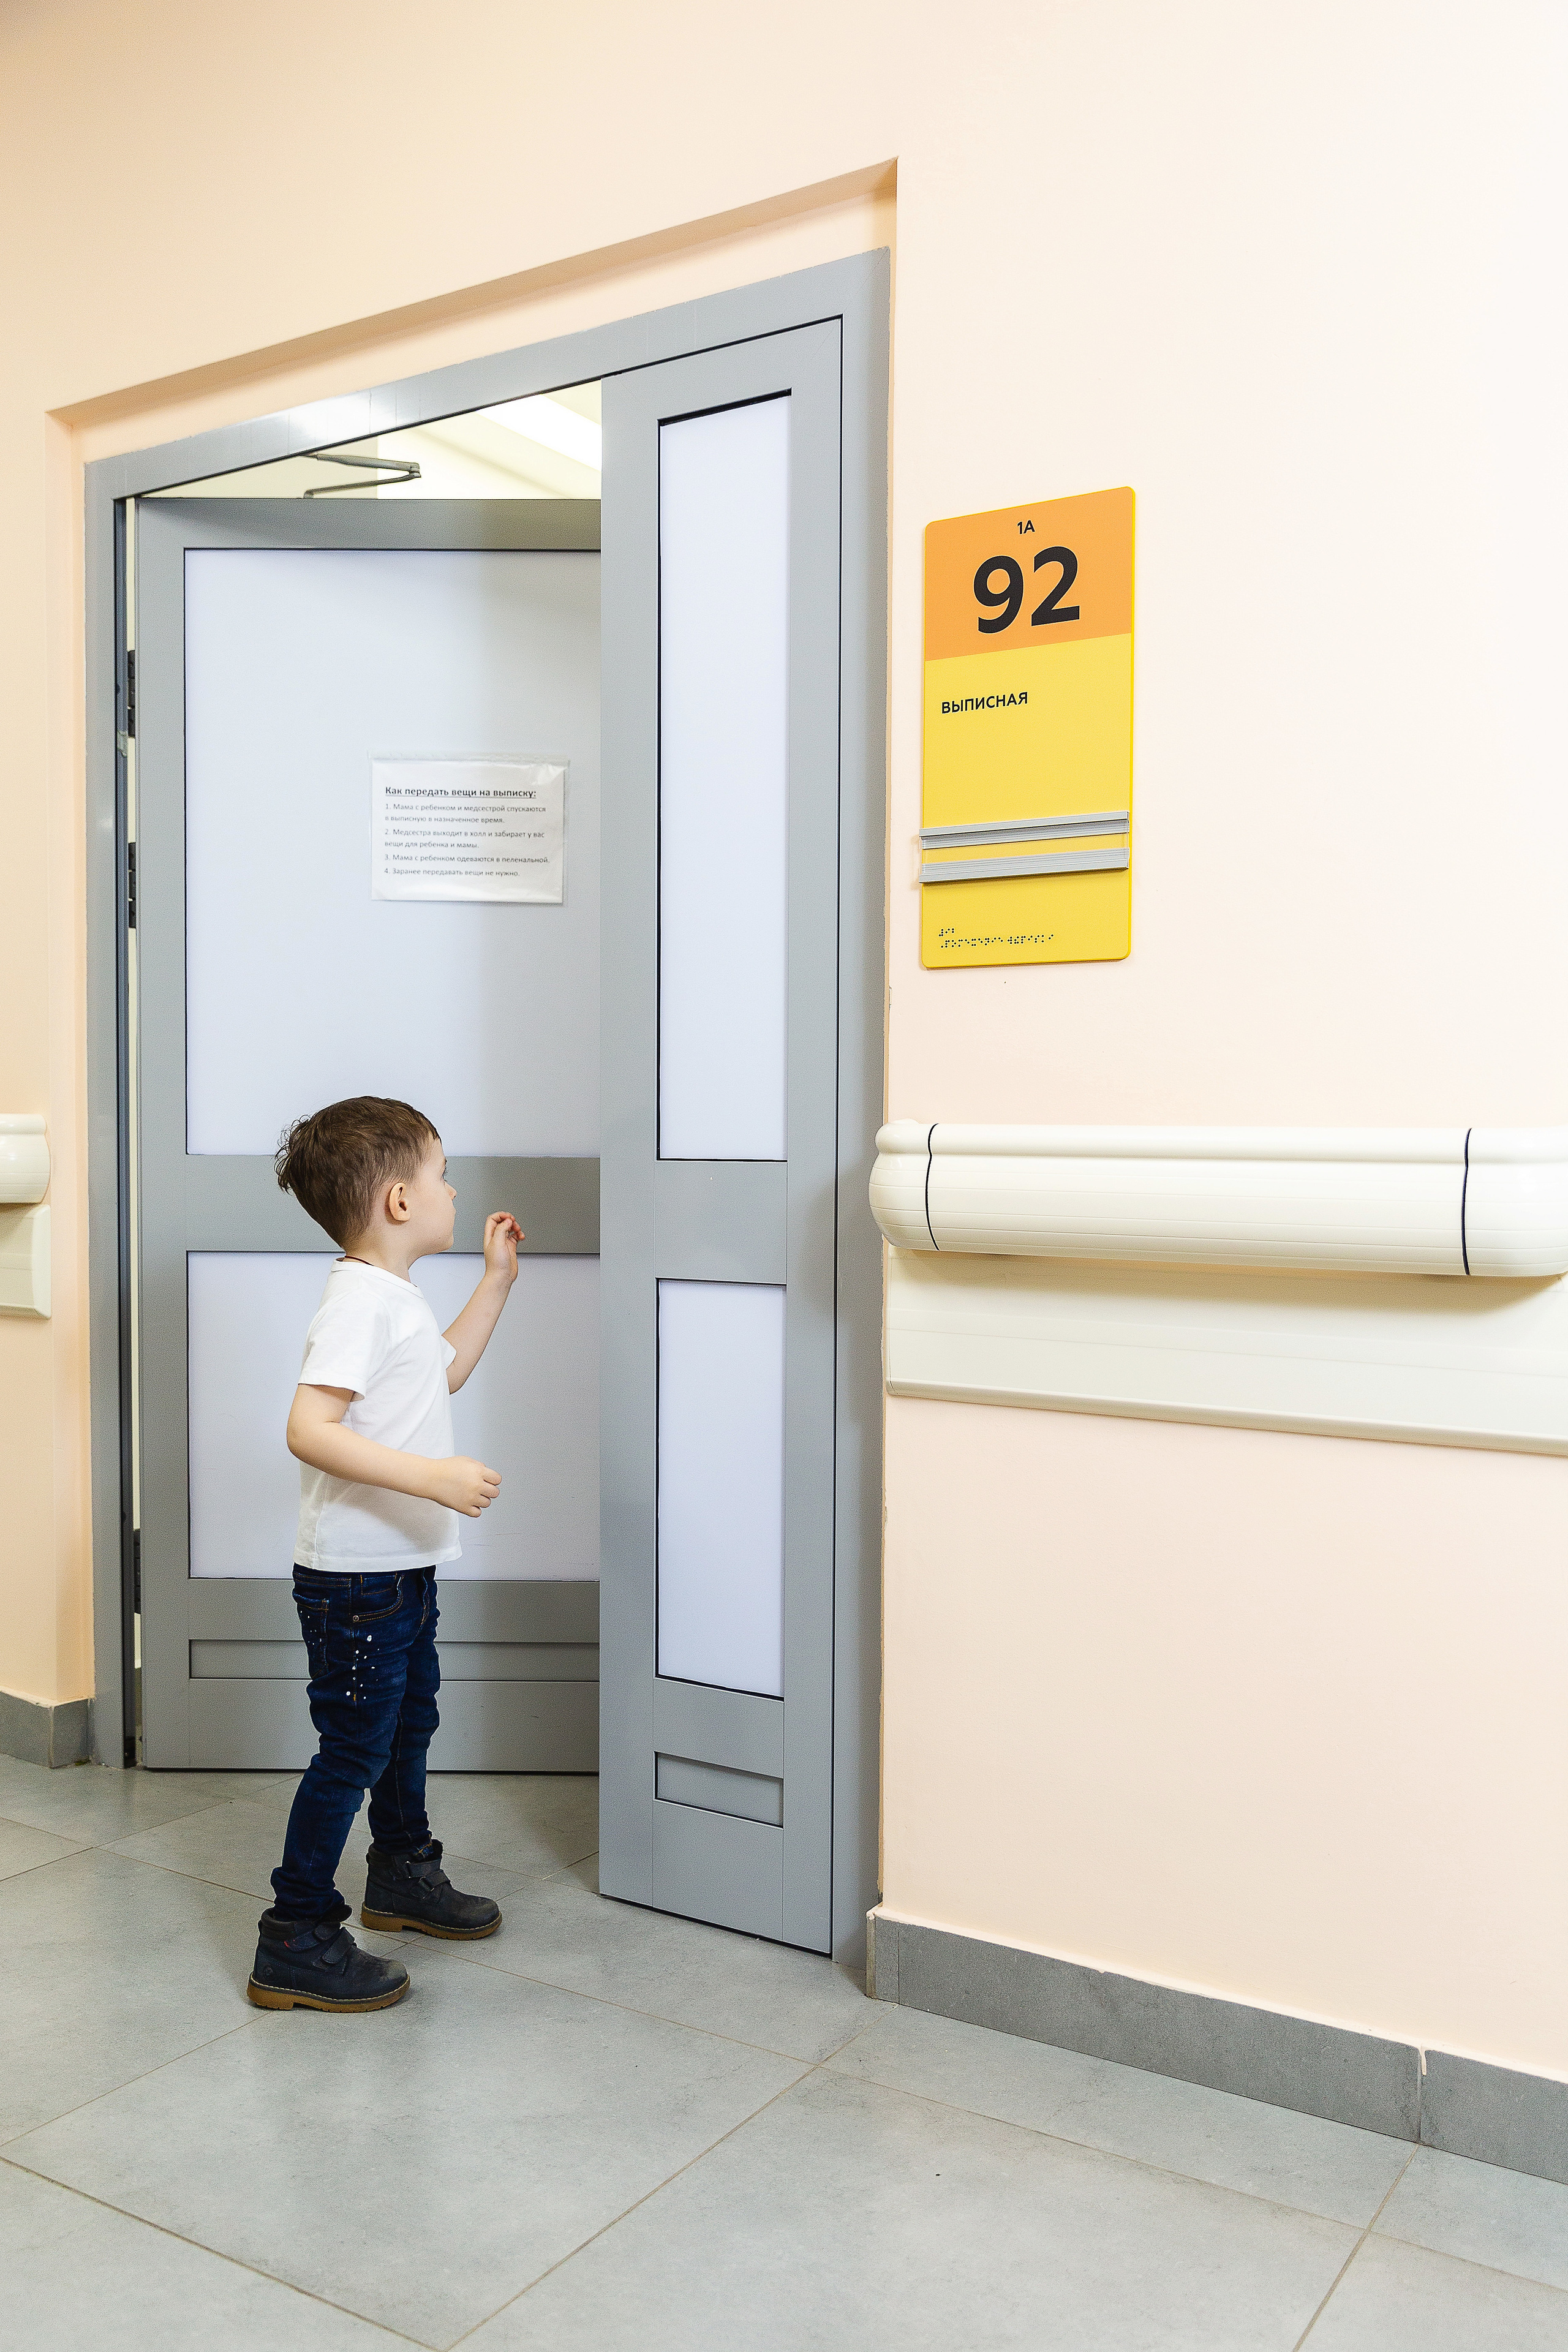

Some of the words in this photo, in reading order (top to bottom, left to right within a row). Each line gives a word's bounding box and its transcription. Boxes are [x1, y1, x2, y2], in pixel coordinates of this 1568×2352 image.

[1017, 519, 1035, 535] 1А
[973, 546, 1080, 634] 92
[941, 692, 1028, 714] ВЫПИСНАЯ
[385, 786, 402, 796] Как
[404, 788, 450, 797] передать
[451, 789, 478, 798] вещи
[492, 790, 537, 799] выписку:
[464, 805, 505, 813] медсестрой
[494, 831, 527, 839] забирает
